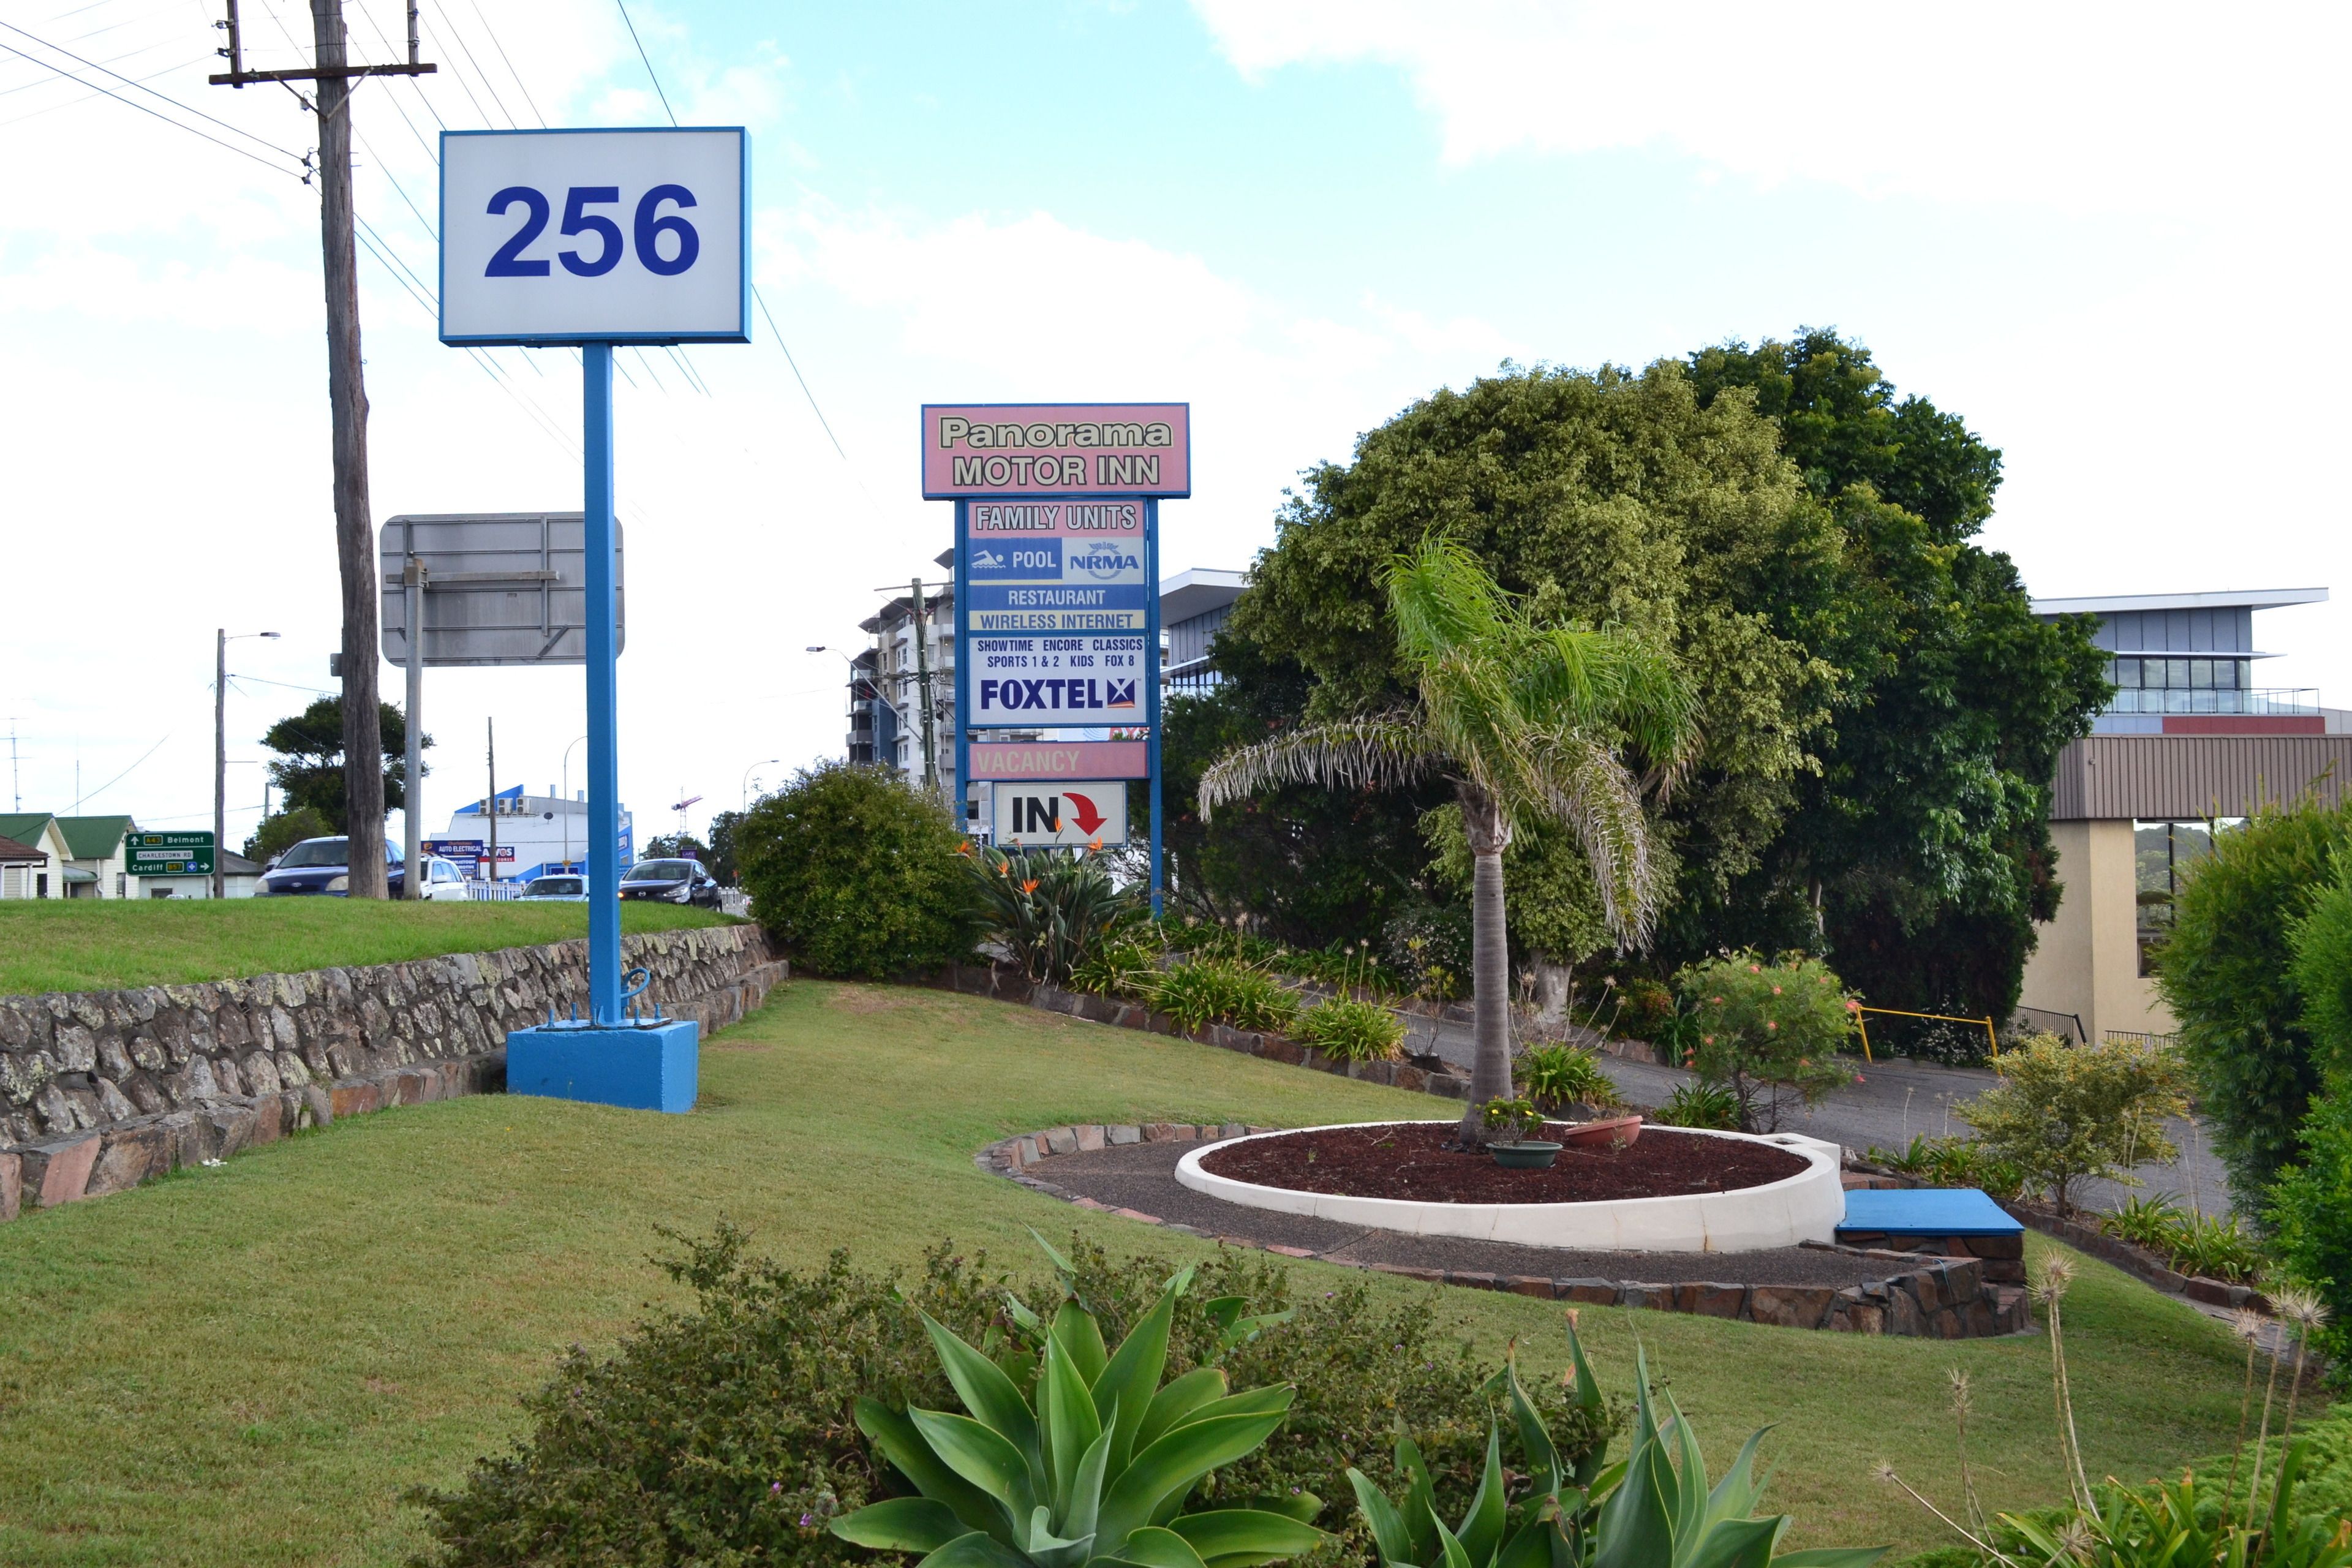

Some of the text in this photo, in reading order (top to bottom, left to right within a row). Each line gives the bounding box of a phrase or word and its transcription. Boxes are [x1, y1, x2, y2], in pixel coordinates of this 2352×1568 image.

[484, 184, 699, 277] 256
[940, 416, 1172, 449] Panorama
[952, 454, 1159, 486] MOTOR INN
[976, 505, 1136, 530] FAMILY UNITS
[1012, 551, 1057, 568] POOL
[1070, 555, 1139, 570] NRMA
[1008, 590, 1106, 605] RESTAURANT
[980, 614, 1133, 629] WIRELESS INTERNET
[978, 638, 1143, 652] SHOWTIME ENCORE CLASSICS
[987, 655, 1135, 668] SPORTS 1 & 2 KIDS FOX 8
[981, 679, 1103, 710] FOXTEL
[976, 750, 1080, 773] VACANCY
[1012, 797, 1059, 833] IN
